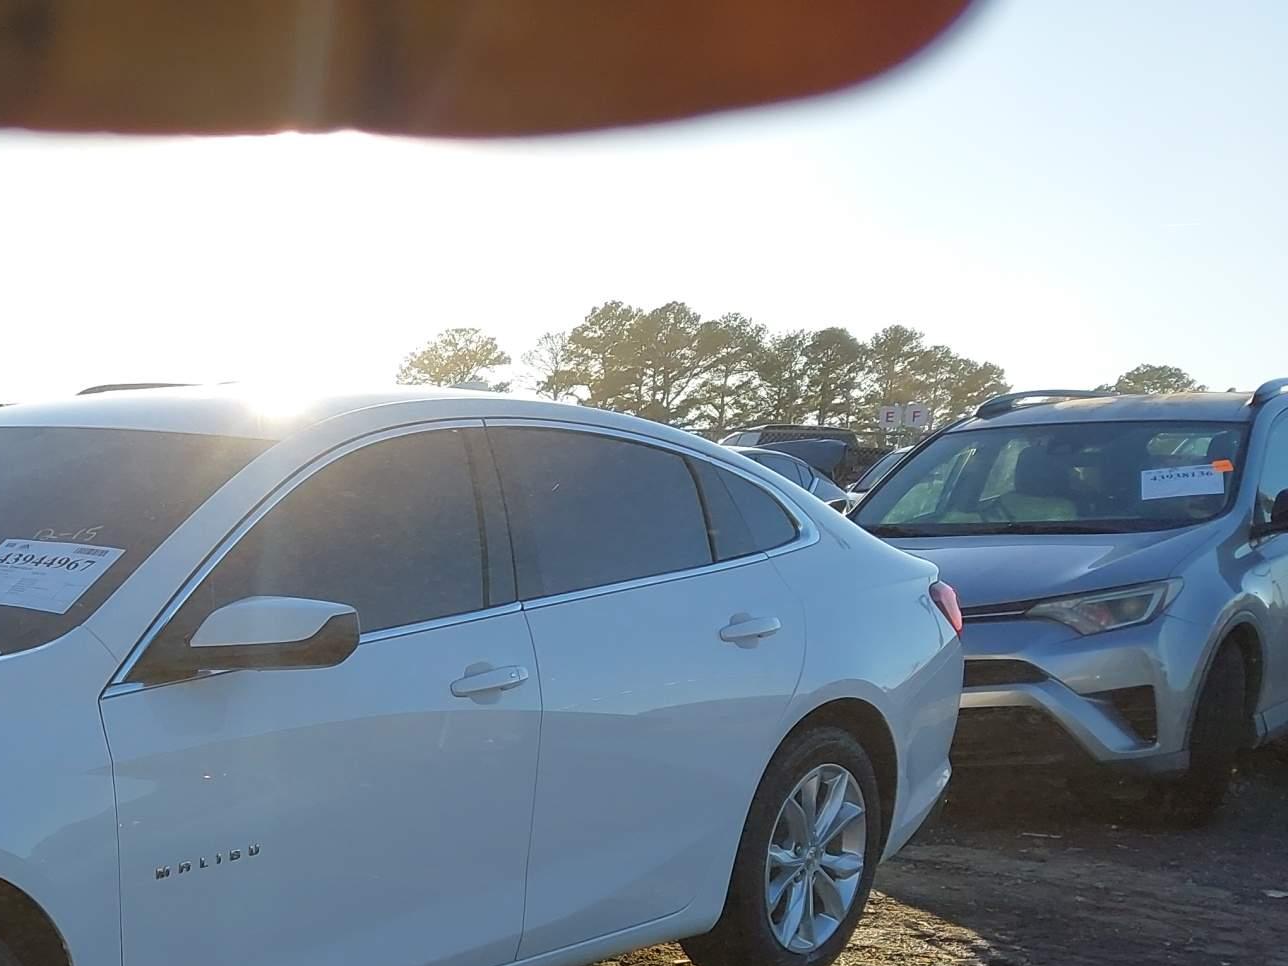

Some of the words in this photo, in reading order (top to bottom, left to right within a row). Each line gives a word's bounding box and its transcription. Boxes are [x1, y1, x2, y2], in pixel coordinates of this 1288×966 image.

[885, 411, 895, 423] E
[912, 410, 921, 423] F
[155, 843, 261, 880] MALIBU
